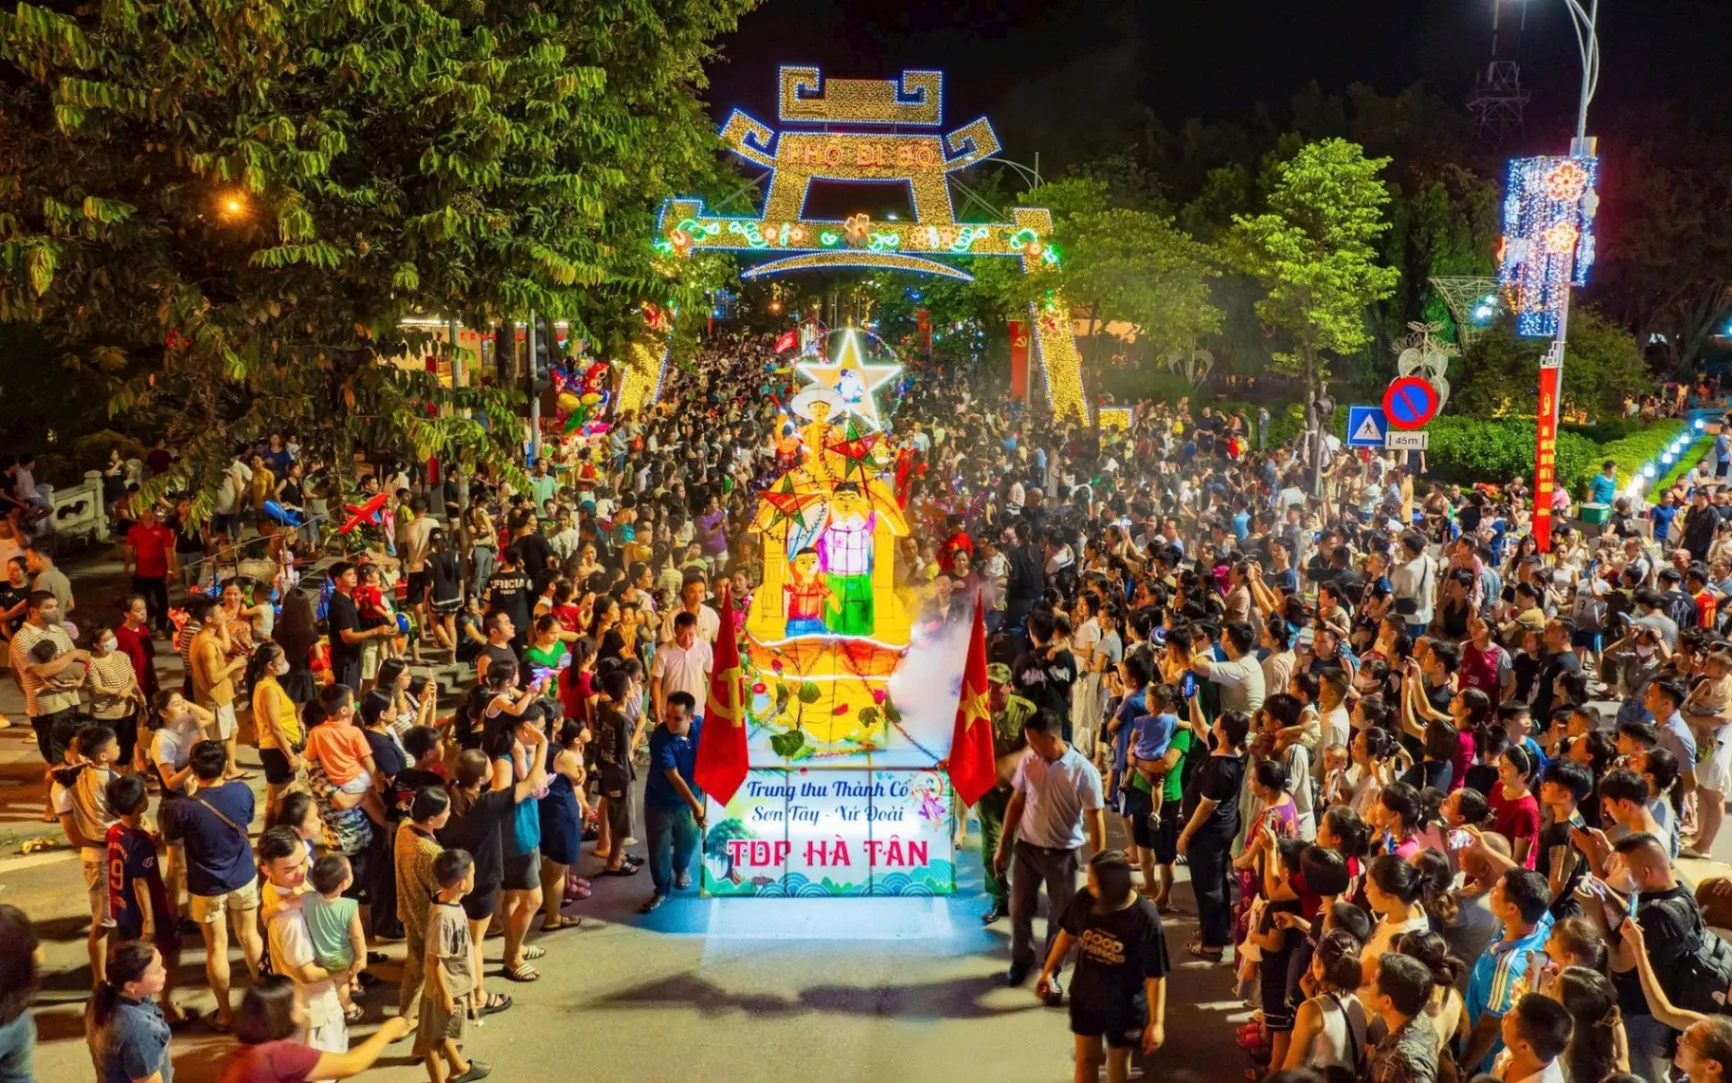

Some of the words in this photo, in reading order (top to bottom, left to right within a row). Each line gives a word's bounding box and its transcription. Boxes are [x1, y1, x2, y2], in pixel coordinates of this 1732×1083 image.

[1395, 436, 1418, 445] 45m
[747, 781, 796, 801] Trung
[801, 782, 827, 797] thu
[832, 781, 884, 797] Thành
[752, 804, 783, 821] Sơn
[835, 804, 860, 821] Xứ
[728, 840, 791, 867] TDP
[803, 834, 851, 867] HÀ
[864, 834, 928, 867] TÂN
